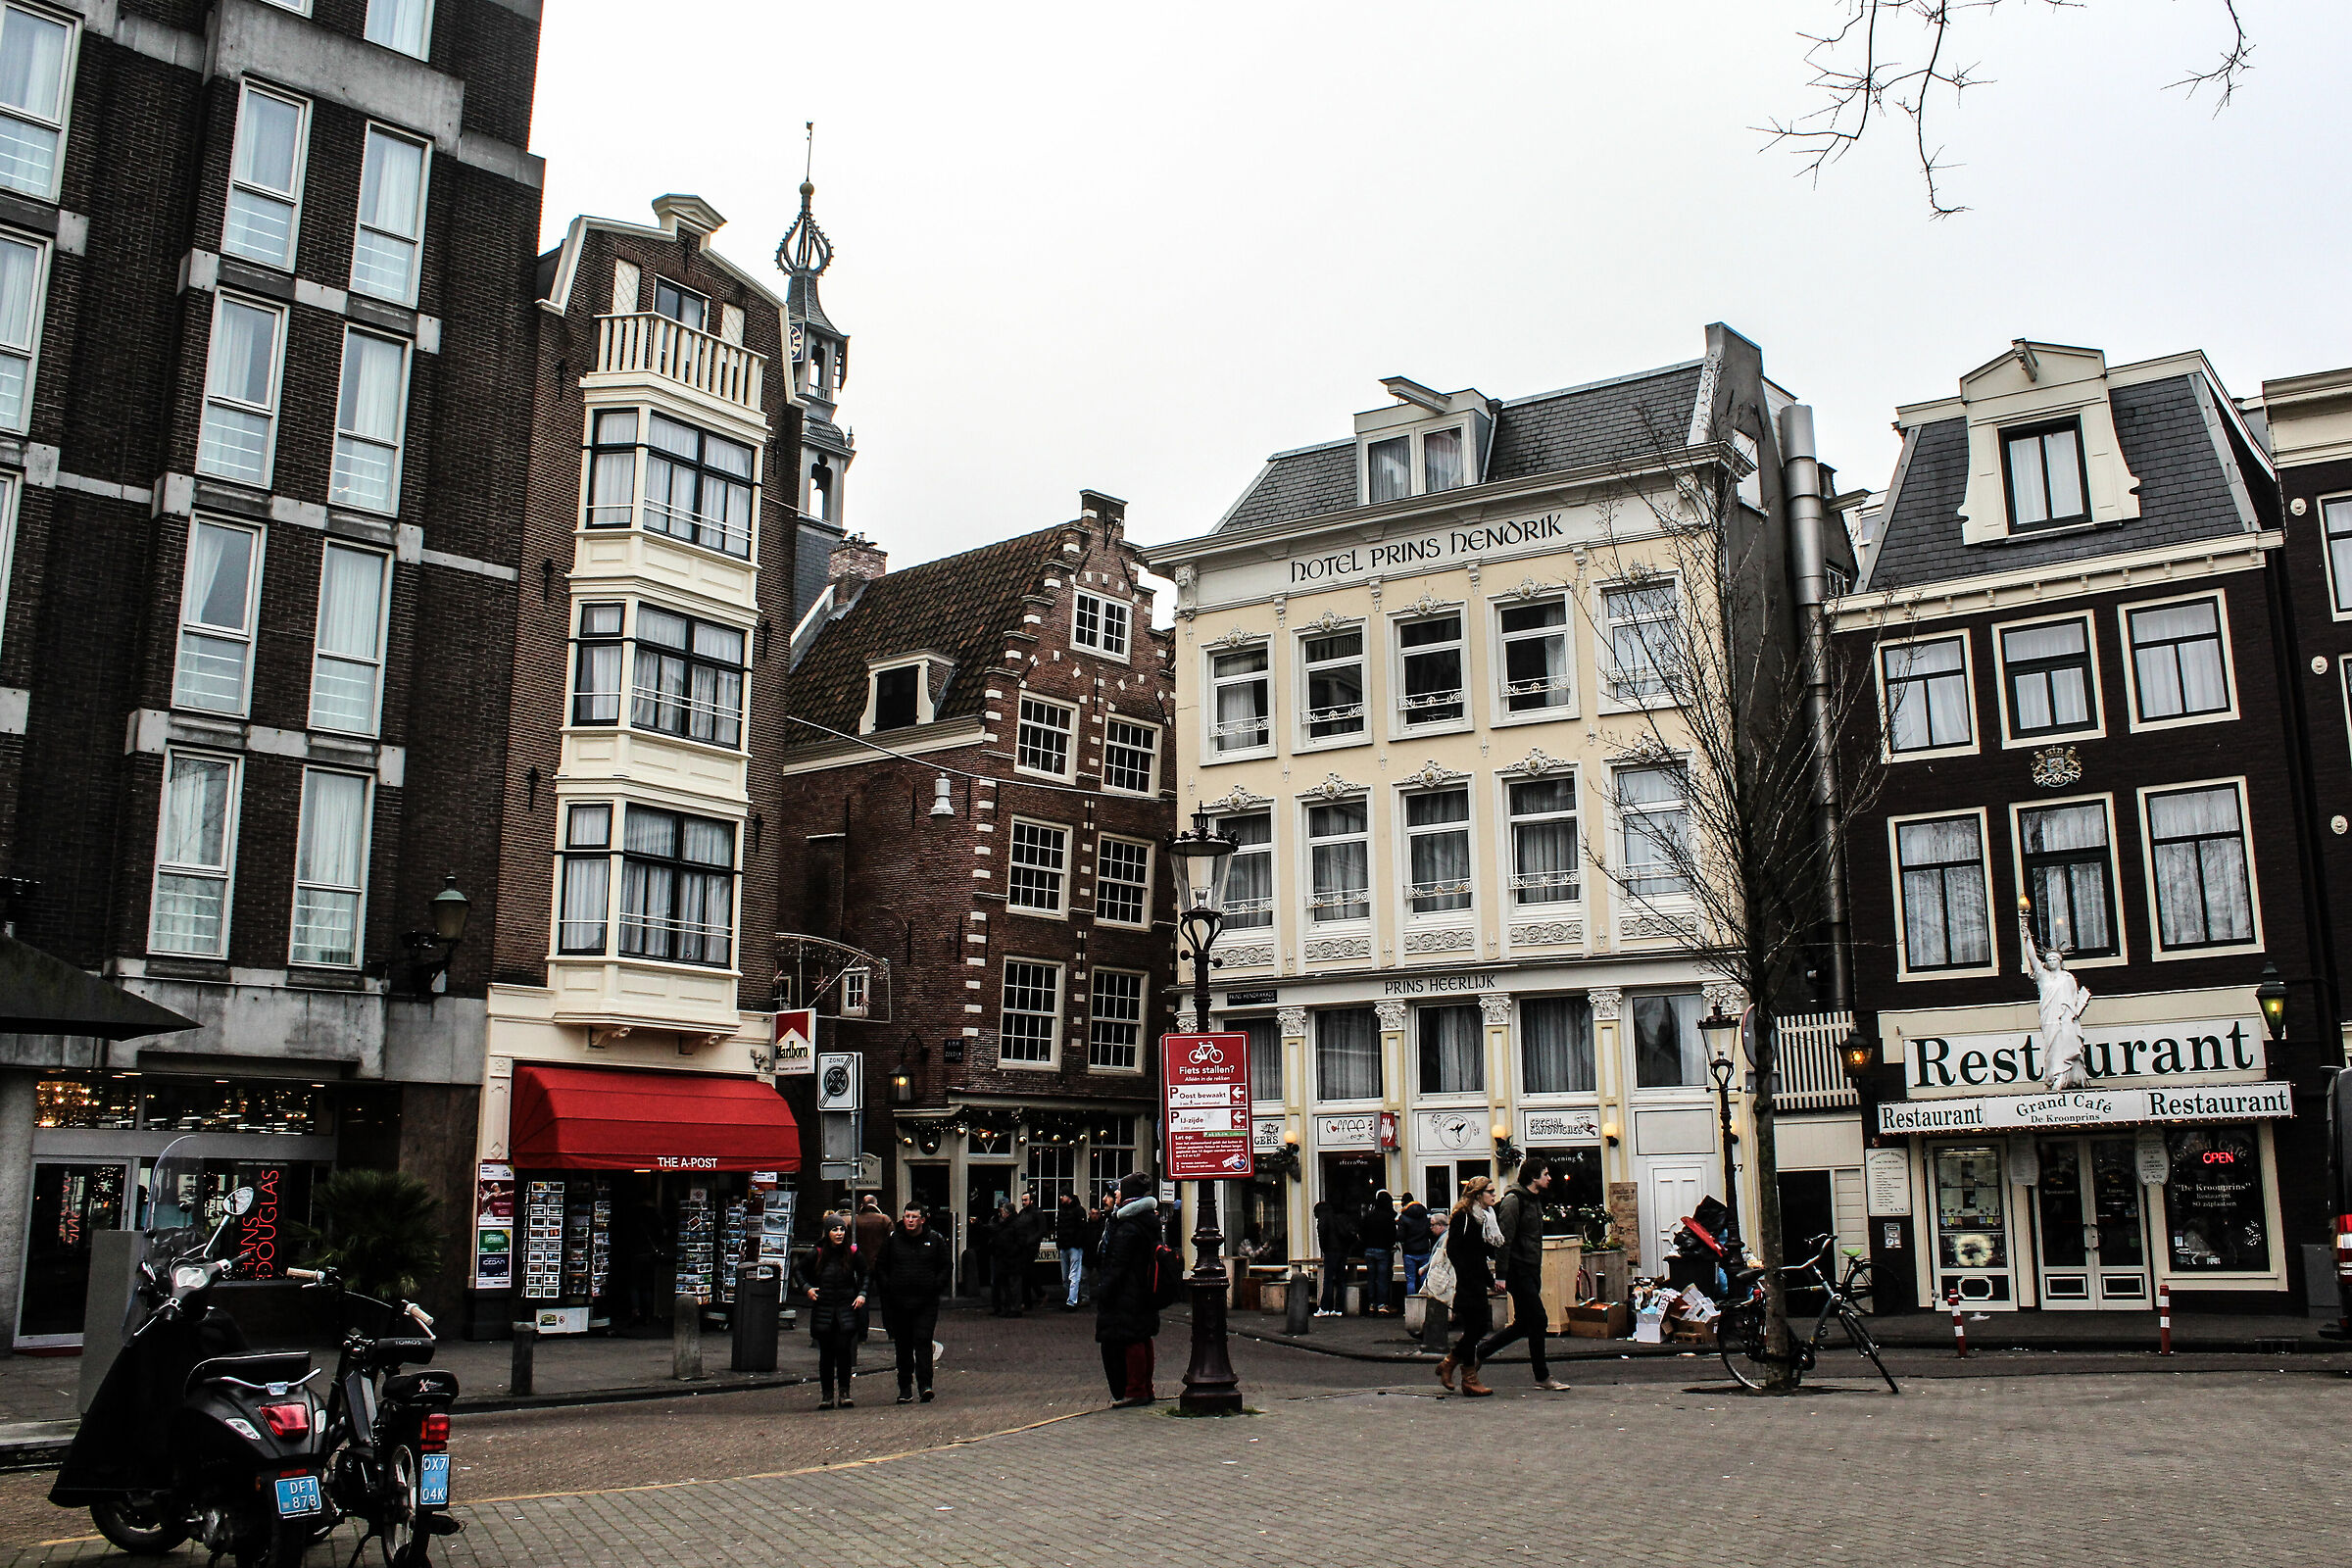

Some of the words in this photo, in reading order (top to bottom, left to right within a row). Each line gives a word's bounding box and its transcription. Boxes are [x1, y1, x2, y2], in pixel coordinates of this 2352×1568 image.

[1291, 550, 1363, 583] HOTEL
[1370, 538, 1441, 567] PRINS
[1450, 514, 1564, 556] HENDRIK
[1385, 980, 1424, 995] PRINS
[1429, 974, 1495, 992] HEERLIJK
[774, 1040, 808, 1058] Marlboro
[1910, 1020, 2254, 1087] Resturant
[1179, 1066, 1200, 1075] Fiets
[1201, 1064, 1235, 1074] stallen?
[1169, 1087, 1179, 1100] P
[2016, 1095, 2068, 1117] Grand
[2074, 1095, 2112, 1113] Café
[2147, 1090, 2289, 1116] Restaurant
[1170, 1111, 1180, 1123] P
[1530, 1117, 1563, 1128] SPECIAL
[1882, 1103, 1984, 1128] Restaurant
[2046, 1113, 2100, 1123] Kroonprins
[1380, 1117, 1395, 1143] illy
[1530, 1124, 1584, 1136] SANDWICHES
[657, 1156, 679, 1168] THE
[680, 1156, 718, 1168] A-POST
[2202, 1152, 2234, 1164] OPEN
[255, 1169, 279, 1278] DOUGLAS
[423, 1457, 447, 1471] DX7
[289, 1480, 314, 1494] DFT
